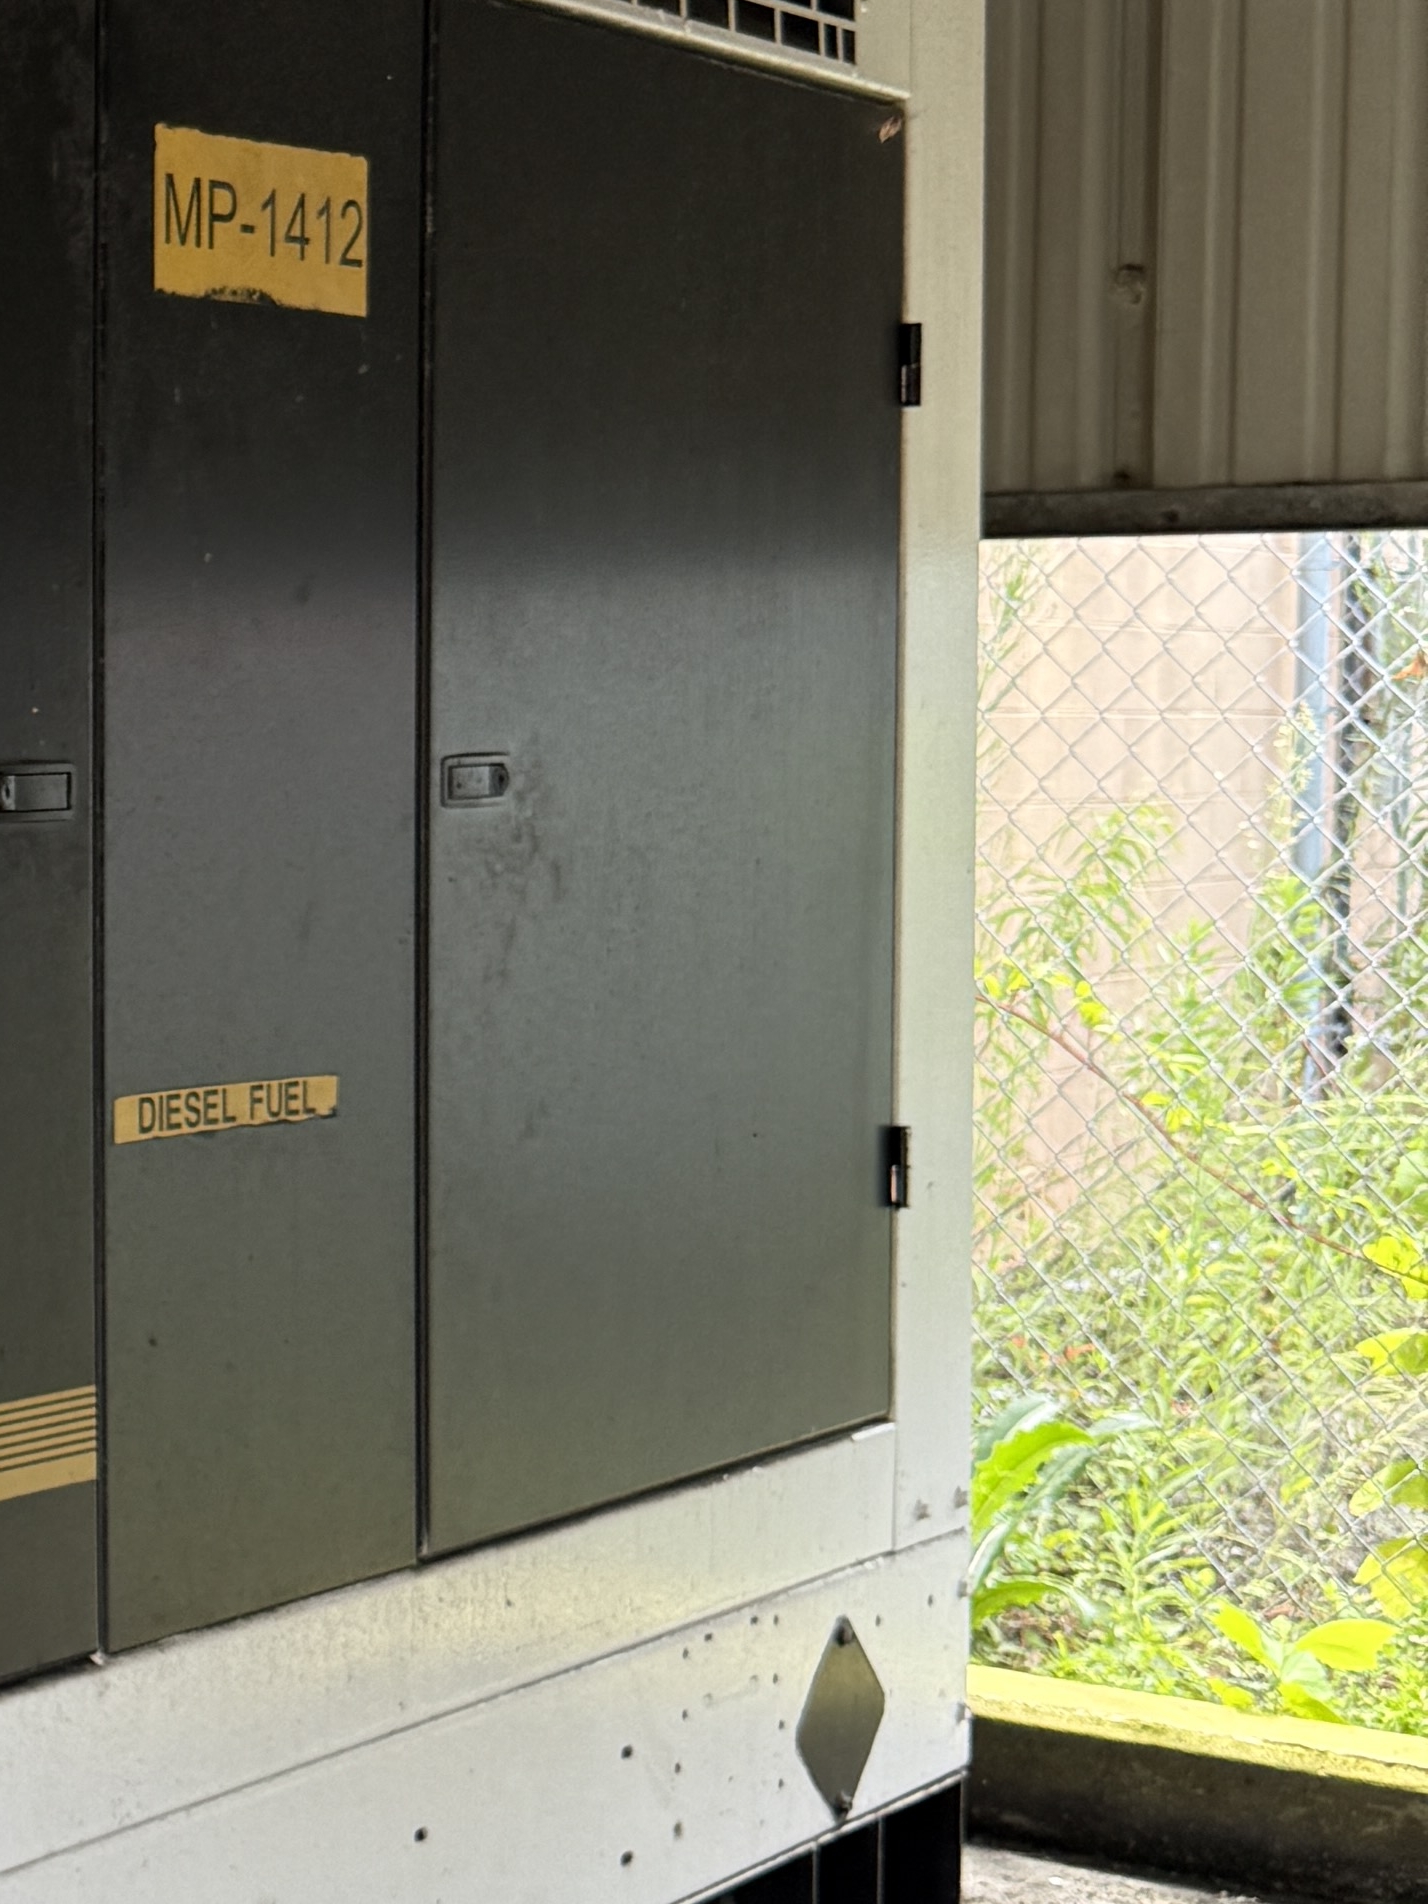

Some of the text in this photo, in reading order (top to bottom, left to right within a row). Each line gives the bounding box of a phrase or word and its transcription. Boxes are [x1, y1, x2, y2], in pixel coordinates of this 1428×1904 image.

[164, 172, 364, 269] MP-1412
[137, 1080, 317, 1135] DIESEL FUEL
